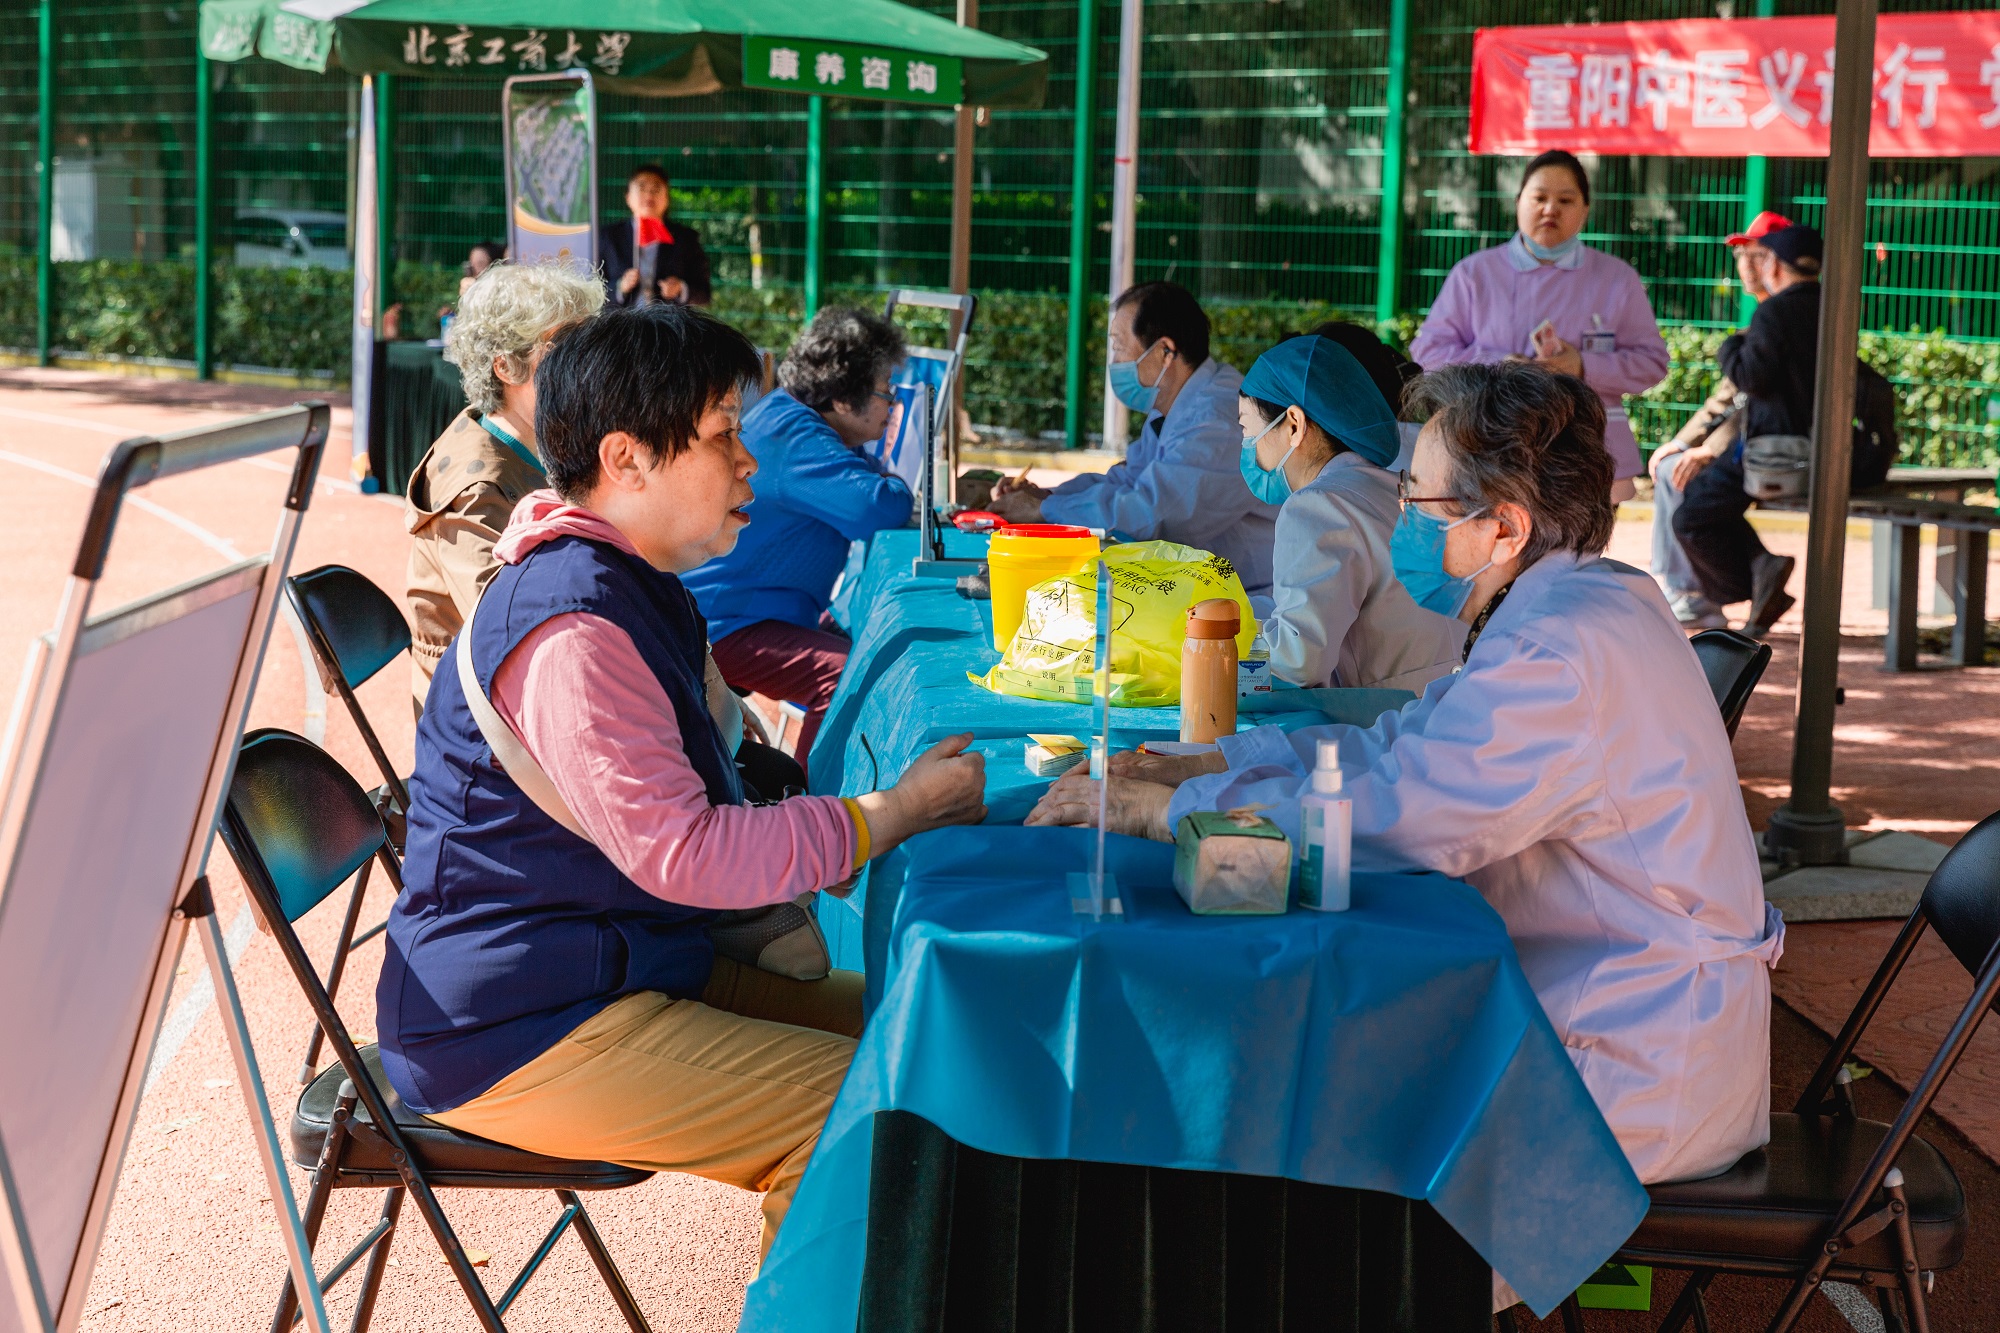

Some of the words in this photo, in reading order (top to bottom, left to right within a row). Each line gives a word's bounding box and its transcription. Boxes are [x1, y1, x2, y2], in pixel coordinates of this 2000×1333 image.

[403, 24, 632, 76] 北京工商大学
[768, 47, 938, 94] 康养咨询
